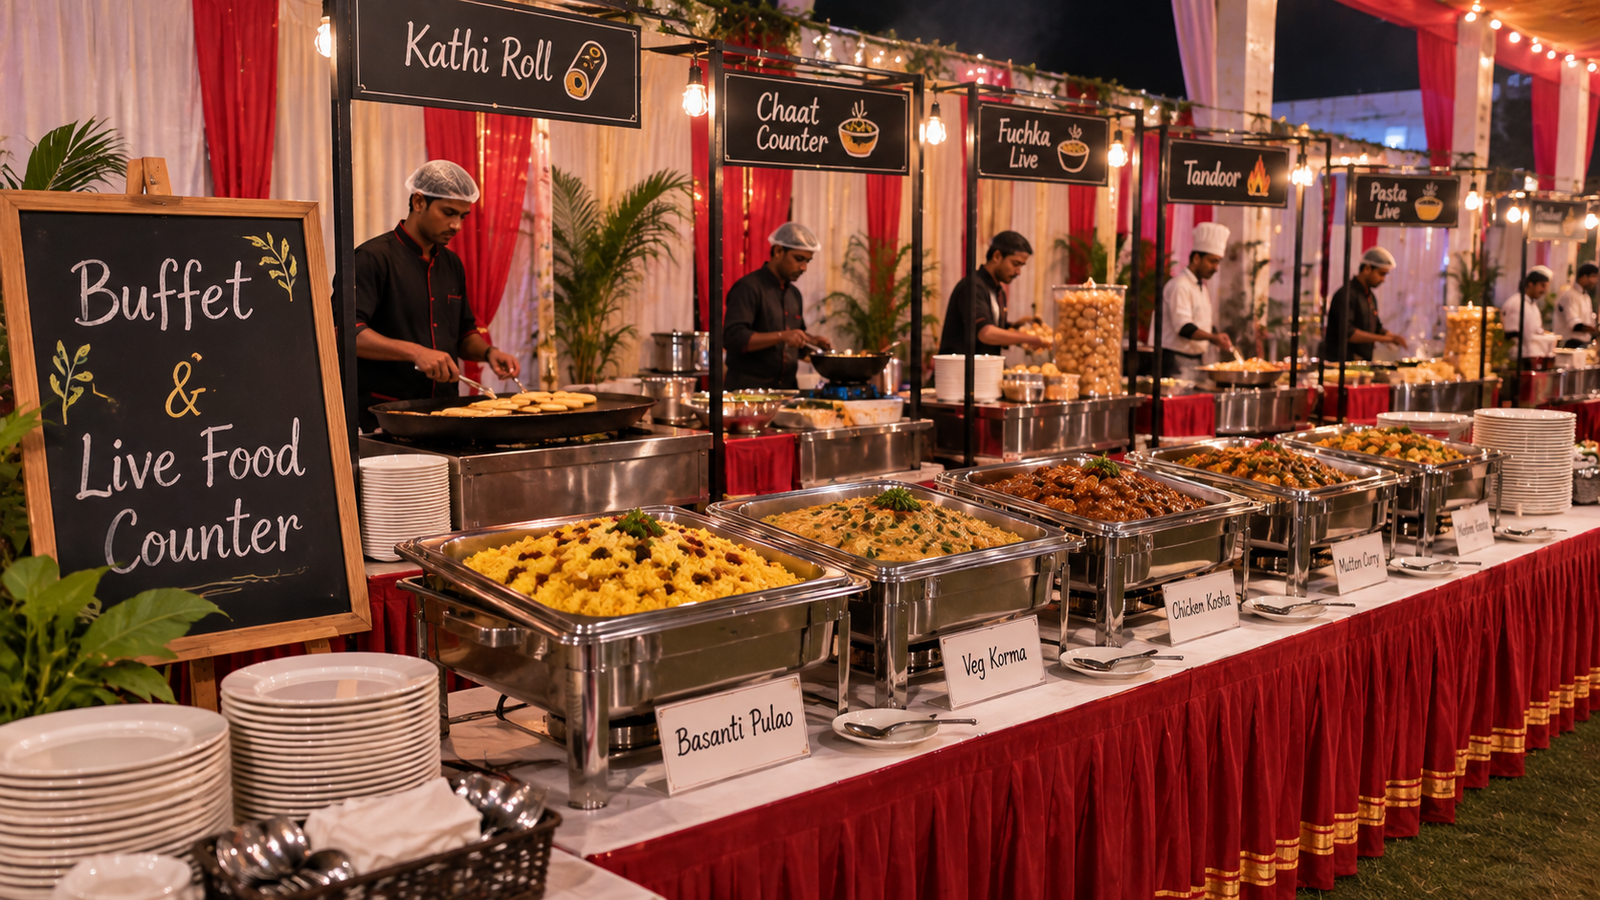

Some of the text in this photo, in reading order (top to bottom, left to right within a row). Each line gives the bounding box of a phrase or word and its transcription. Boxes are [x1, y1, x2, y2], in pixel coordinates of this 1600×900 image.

[405, 20, 554, 82] Kathi Roll
[756, 92, 820, 126] Chaat
[756, 125, 830, 154] Counter
[998, 117, 1051, 147] Fuchka
[1009, 146, 1039, 169] Live
[1184, 160, 1241, 188] Tandoor
[1370, 181, 1407, 202] Pasta
[1375, 202, 1400, 220] Live
[71, 258, 254, 331] Buffet
[165, 359, 206, 418] &
[75, 417, 306, 501] Live Food
[104, 498, 303, 575] Counter
[1172, 590, 1232, 620] Chicken Kosha
[962, 645, 1028, 681] Veg Korma
[675, 704, 794, 757] Basanti Pulao
